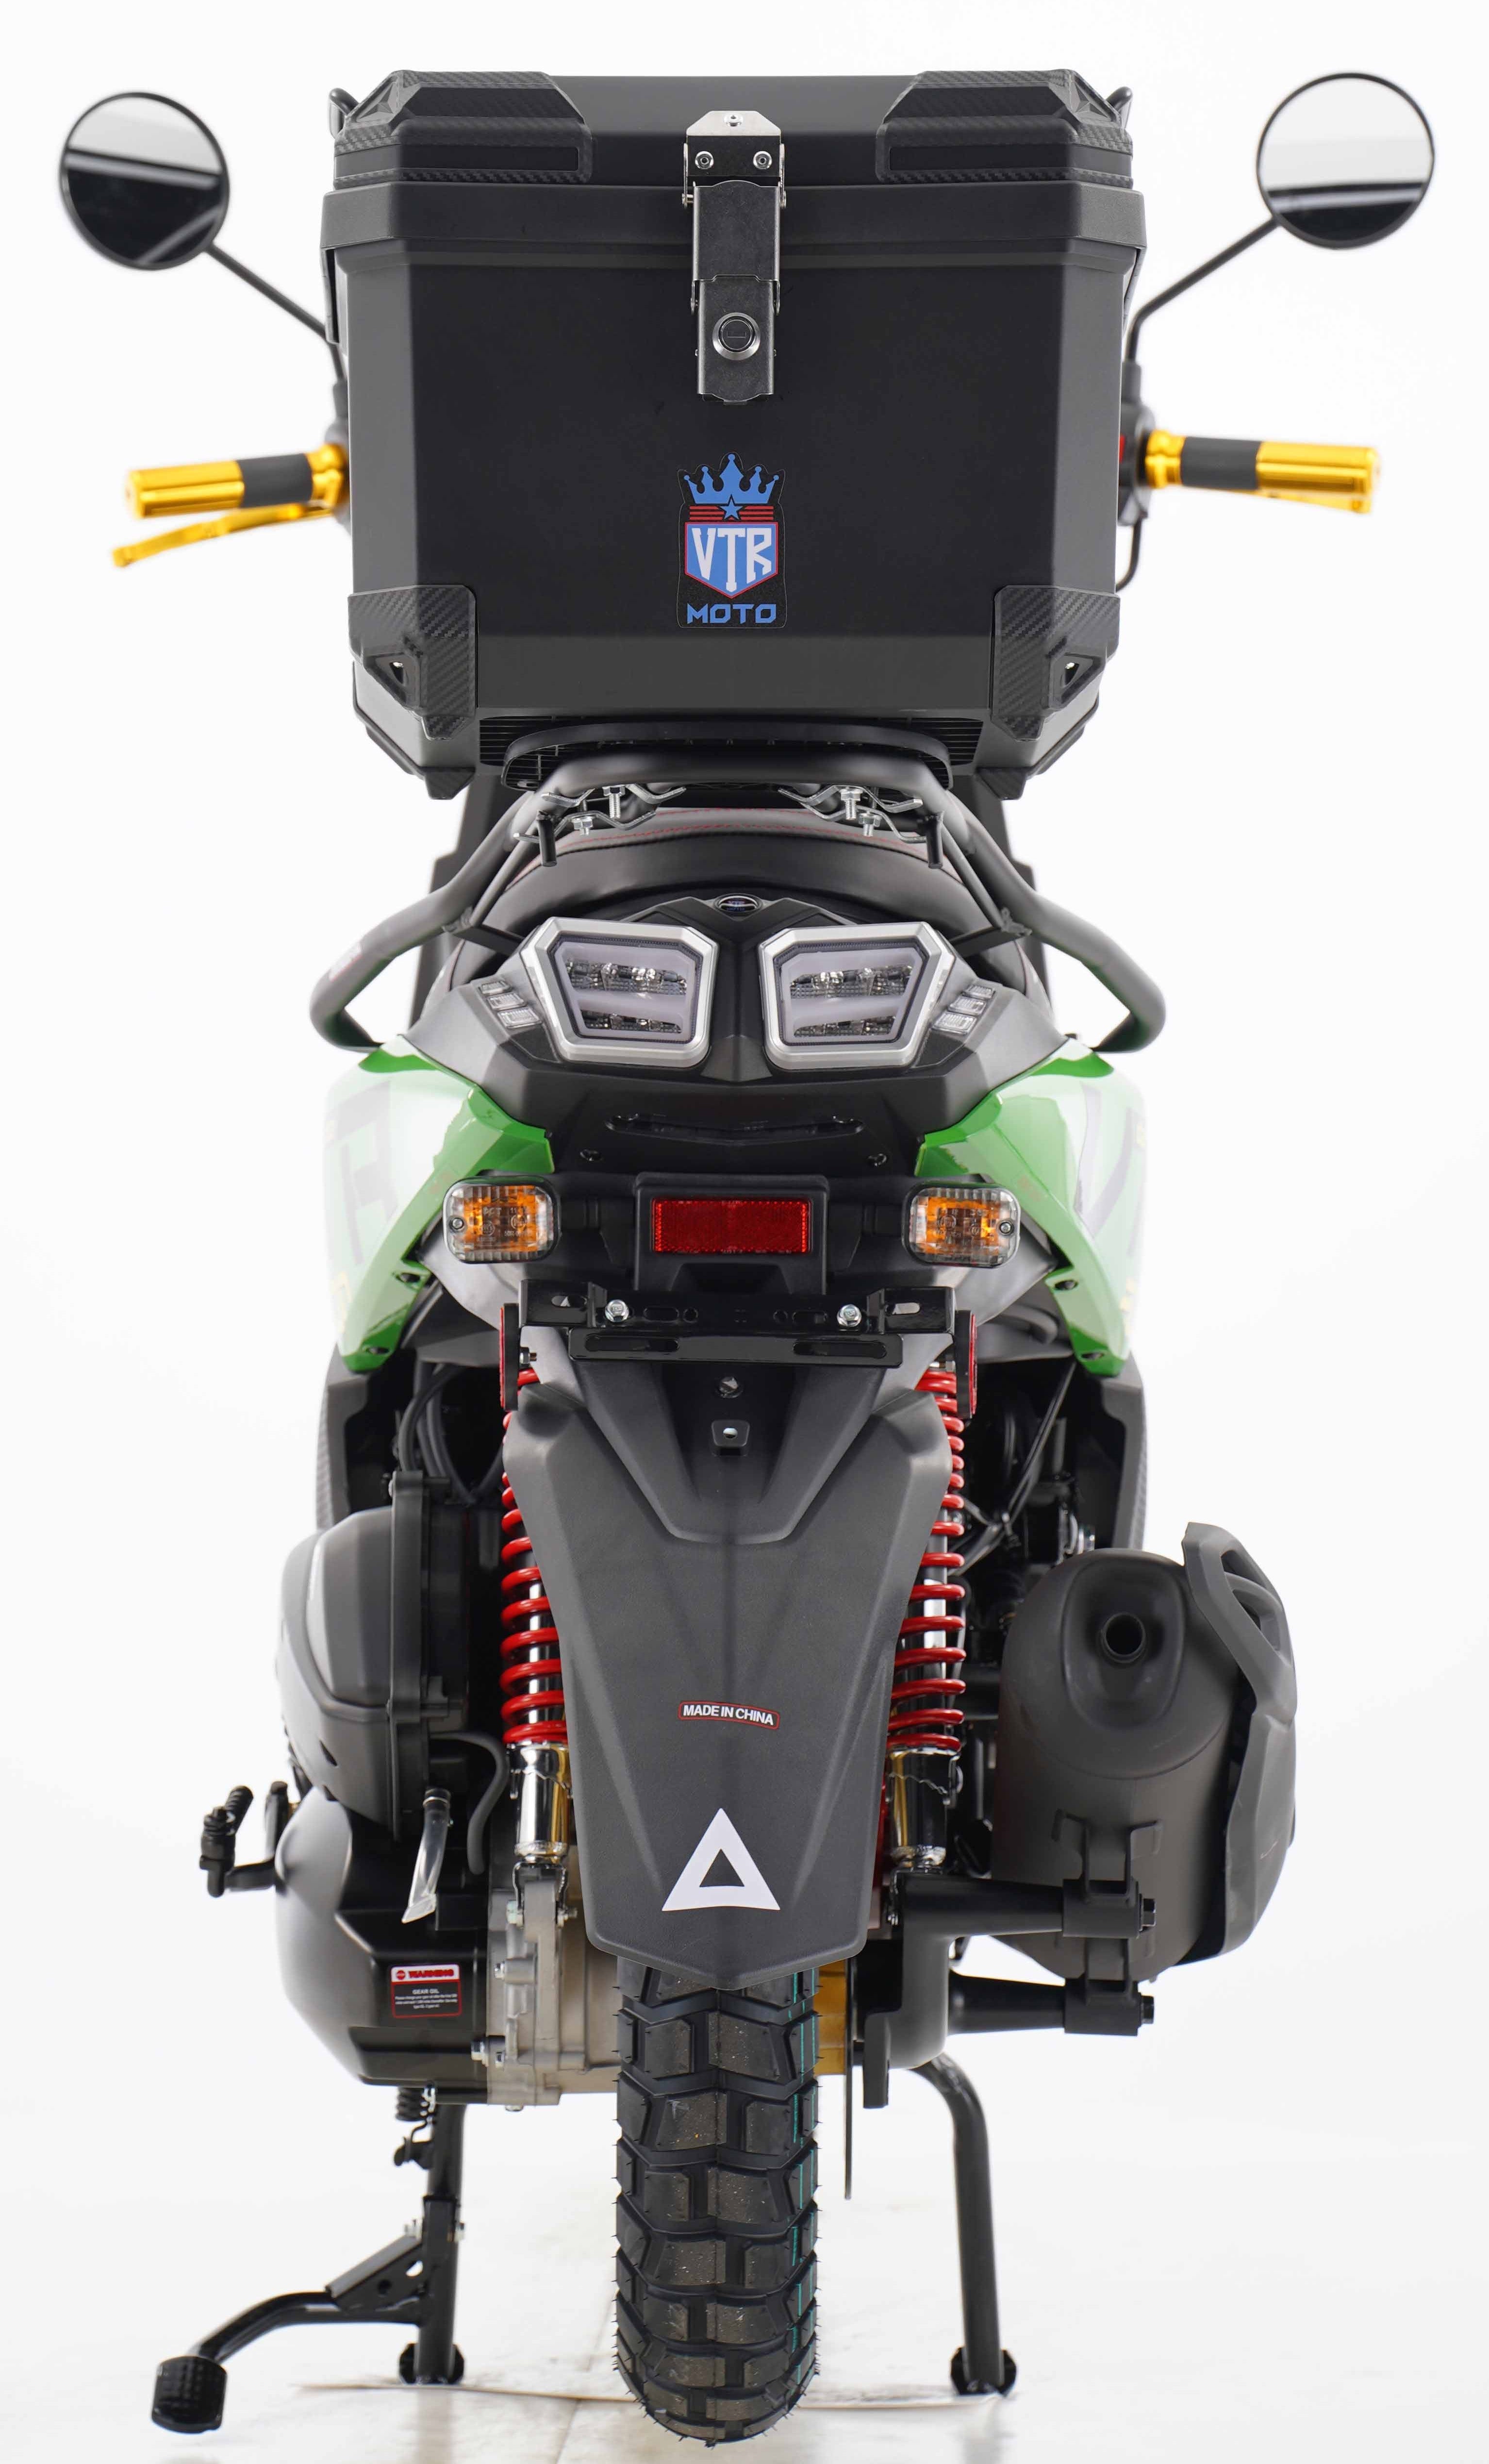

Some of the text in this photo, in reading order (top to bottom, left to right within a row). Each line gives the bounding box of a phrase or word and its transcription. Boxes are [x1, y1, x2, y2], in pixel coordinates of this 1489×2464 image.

[692, 528, 772, 592] VTR
[687, 603, 777, 624] MOTO
[683, 1705, 774, 1725] MADE IN CHINA
